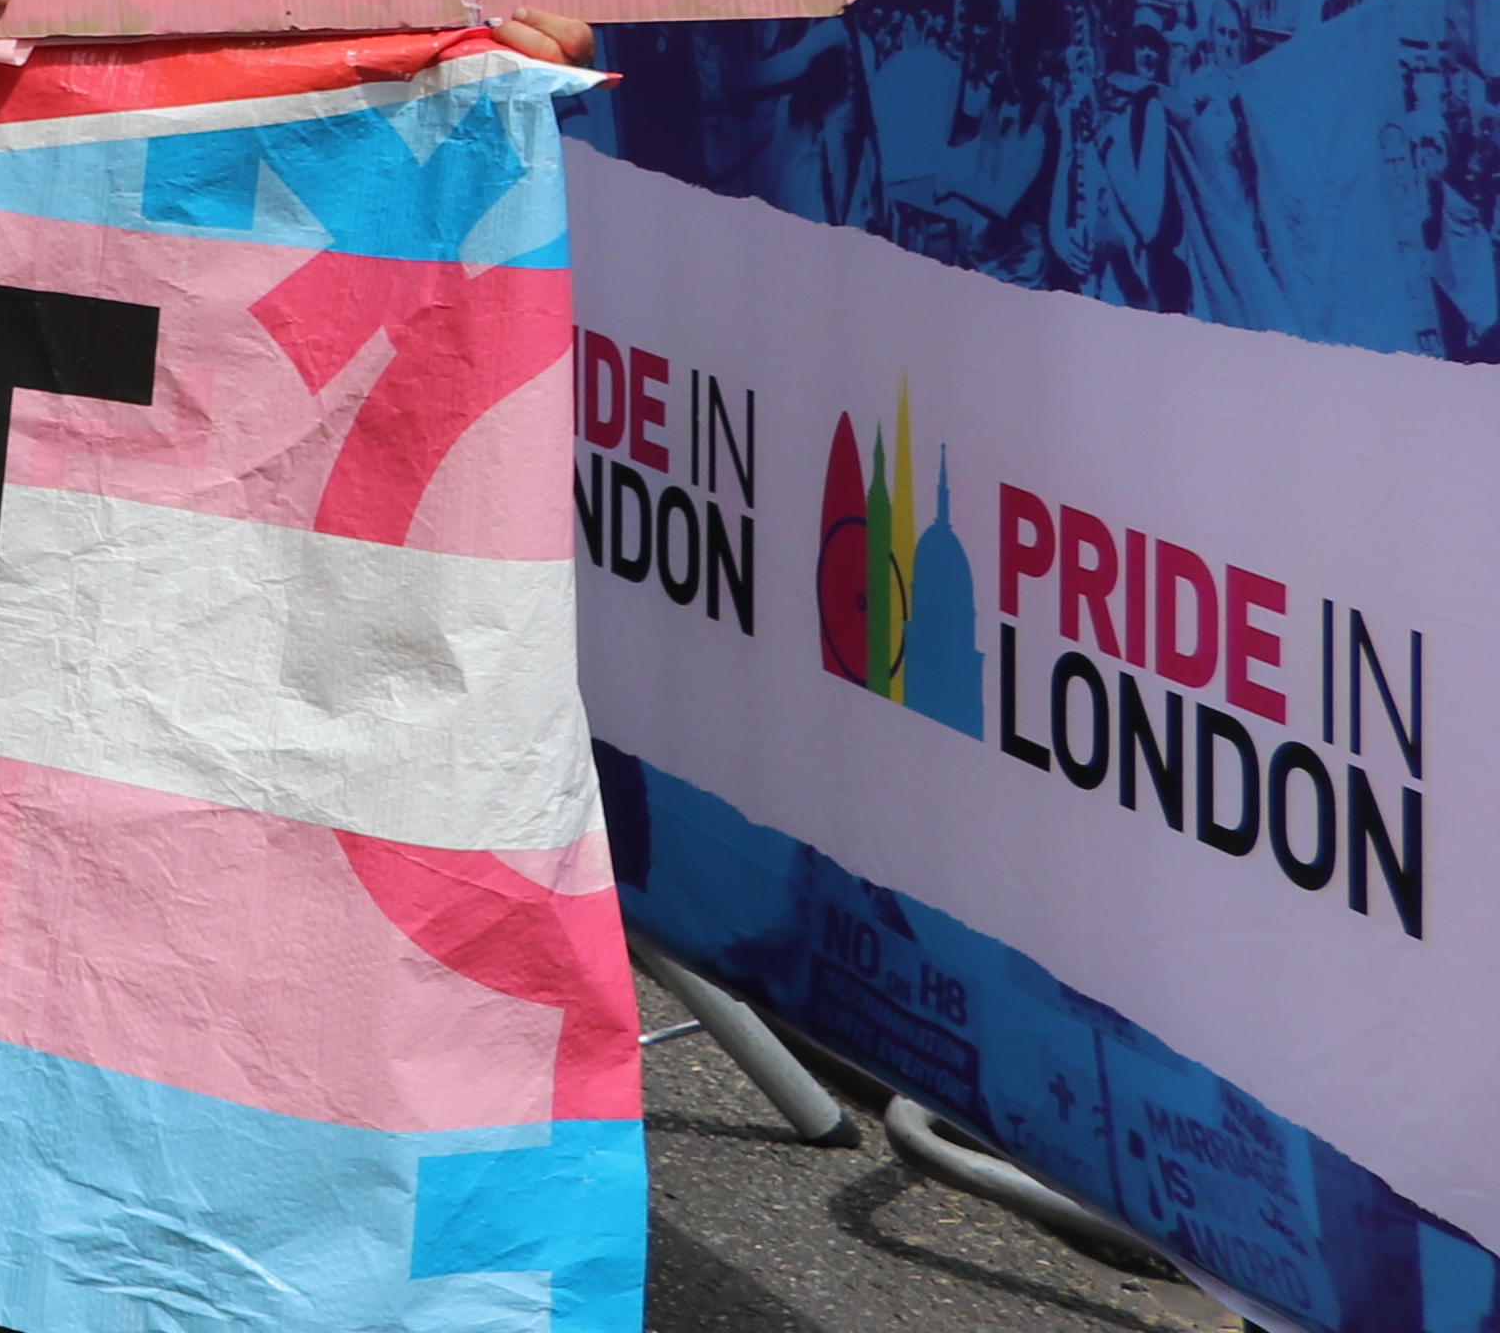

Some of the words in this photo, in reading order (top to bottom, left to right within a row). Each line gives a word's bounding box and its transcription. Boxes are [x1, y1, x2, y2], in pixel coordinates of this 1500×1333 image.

[691, 368, 755, 511] IN
[999, 482, 1287, 726] PRIDE
[1322, 597, 1423, 780] IN
[999, 623, 1424, 941] LONDON
